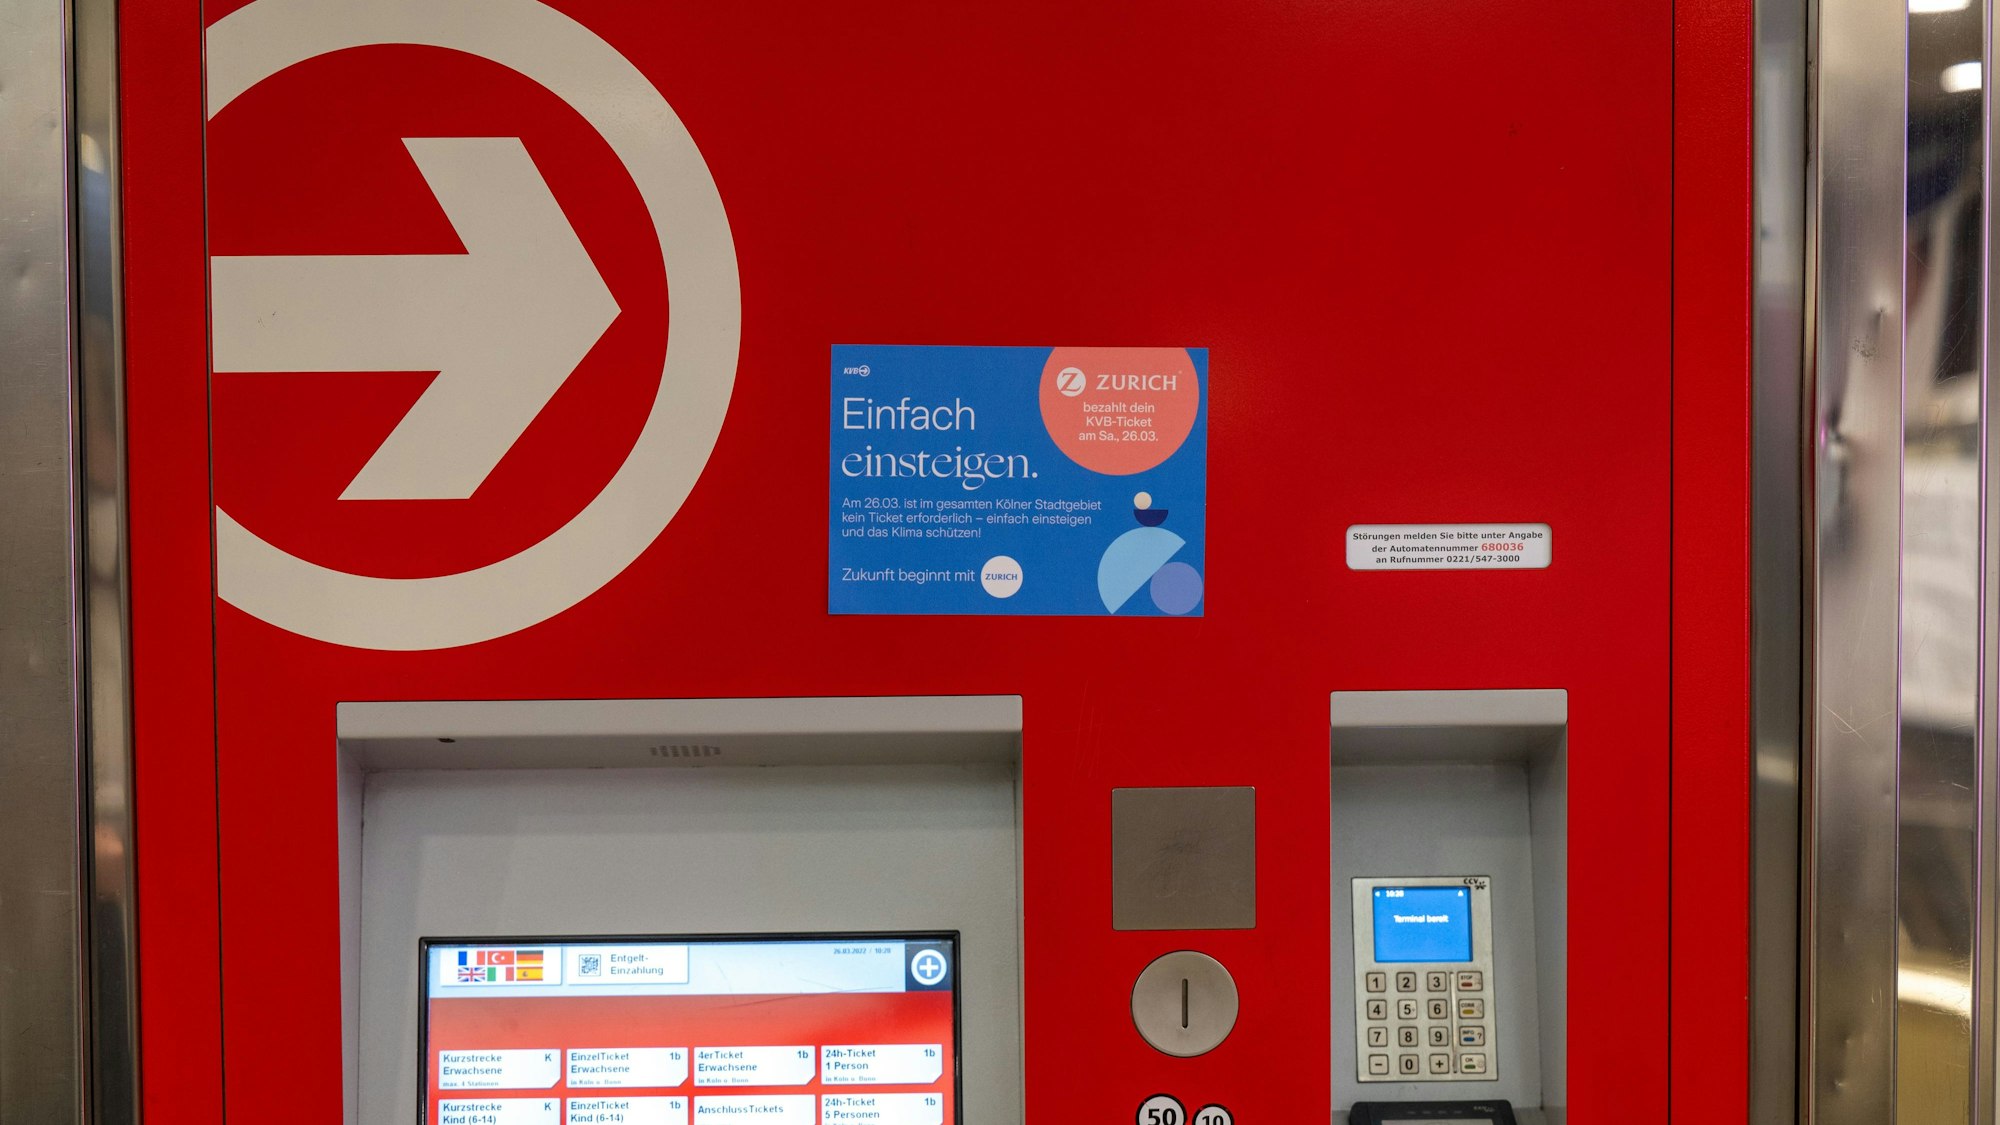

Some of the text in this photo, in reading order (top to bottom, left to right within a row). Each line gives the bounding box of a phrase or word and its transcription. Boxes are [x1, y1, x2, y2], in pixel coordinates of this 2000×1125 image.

[843, 367, 859, 375] KVB
[1096, 374, 1177, 391] ZURICH
[1083, 401, 1155, 413] bezahlt dein
[843, 397, 976, 431] Einfach
[1086, 416, 1152, 427] KVB-Ticket
[1078, 430, 1159, 443] am Sa., 26.03.
[841, 445, 1038, 491] einsteigen.
[842, 497, 1102, 513] Am 26.03. ist im gesamten Kölner Stadtgebiet
[842, 512, 865, 523] kein
[868, 512, 903, 523] Ticket
[906, 512, 973, 524] erforderlich
[986, 513, 1029, 524] einfach
[1032, 513, 1092, 527] einsteigen
[842, 526, 982, 538] und das Klima schützen!
[1352, 532, 1400, 541] Störungen
[1403, 532, 1437, 540] melden
[1439, 532, 1454, 540] Sie
[1457, 531, 1478, 539] bitte
[1508, 531, 1543, 540] Angabe
[1371, 542, 1524, 553] der Automatennummer 680036
[1446, 555, 1520, 563] 0221/547-3000
[842, 568, 1018, 585] Zukunft beginnt mit ZURICH
[1393, 914, 1449, 923] Terminal bereit
[610, 953, 649, 963] Entgelt-
[610, 966, 664, 975] Einzahlung
[1373, 977, 1379, 988] 1
[1402, 977, 1410, 988] 2
[1433, 977, 1441, 988] 3
[1373, 1004, 1381, 1015] 4
[1403, 1004, 1411, 1015] 5
[1433, 1004, 1441, 1015] 6
[1374, 1032, 1381, 1042] 7
[1404, 1032, 1412, 1042] 8
[1434, 1032, 1442, 1042] 9
[544, 1053, 552, 1062] K
[571, 1052, 629, 1061] EinzelTicket
[669, 1052, 681, 1061] 1b
[698, 1050, 743, 1059] 4erTicket
[797, 1050, 809, 1059] 1b
[825, 1049, 876, 1058] 24h-Ticket
[924, 1048, 935, 1057] 1b
[443, 1053, 502, 1063] Kurzstrecke
[571, 1064, 630, 1073] Erwachsene
[698, 1063, 757, 1072] Erwachsene
[825, 1061, 869, 1070] 1 Person
[1405, 1059, 1413, 1070] 0
[443, 1066, 503, 1075] Erwachsene
[443, 1102, 502, 1112] Kurzstrecke
[544, 1102, 552, 1111] K
[571, 1101, 629, 1110] EinzelTicket
[669, 1101, 681, 1109] 1b
[825, 1098, 876, 1107] 24h-Ticket
[924, 1098, 936, 1106] 1b
[698, 1105, 784, 1115] AnschlussTickets
[825, 1110, 880, 1119] 5 Personen
[443, 1114, 497, 1125] Kind (6-14)
[571, 1113, 624, 1124] Kind (6-14)
[1148, 1108, 1177, 1125] 50
